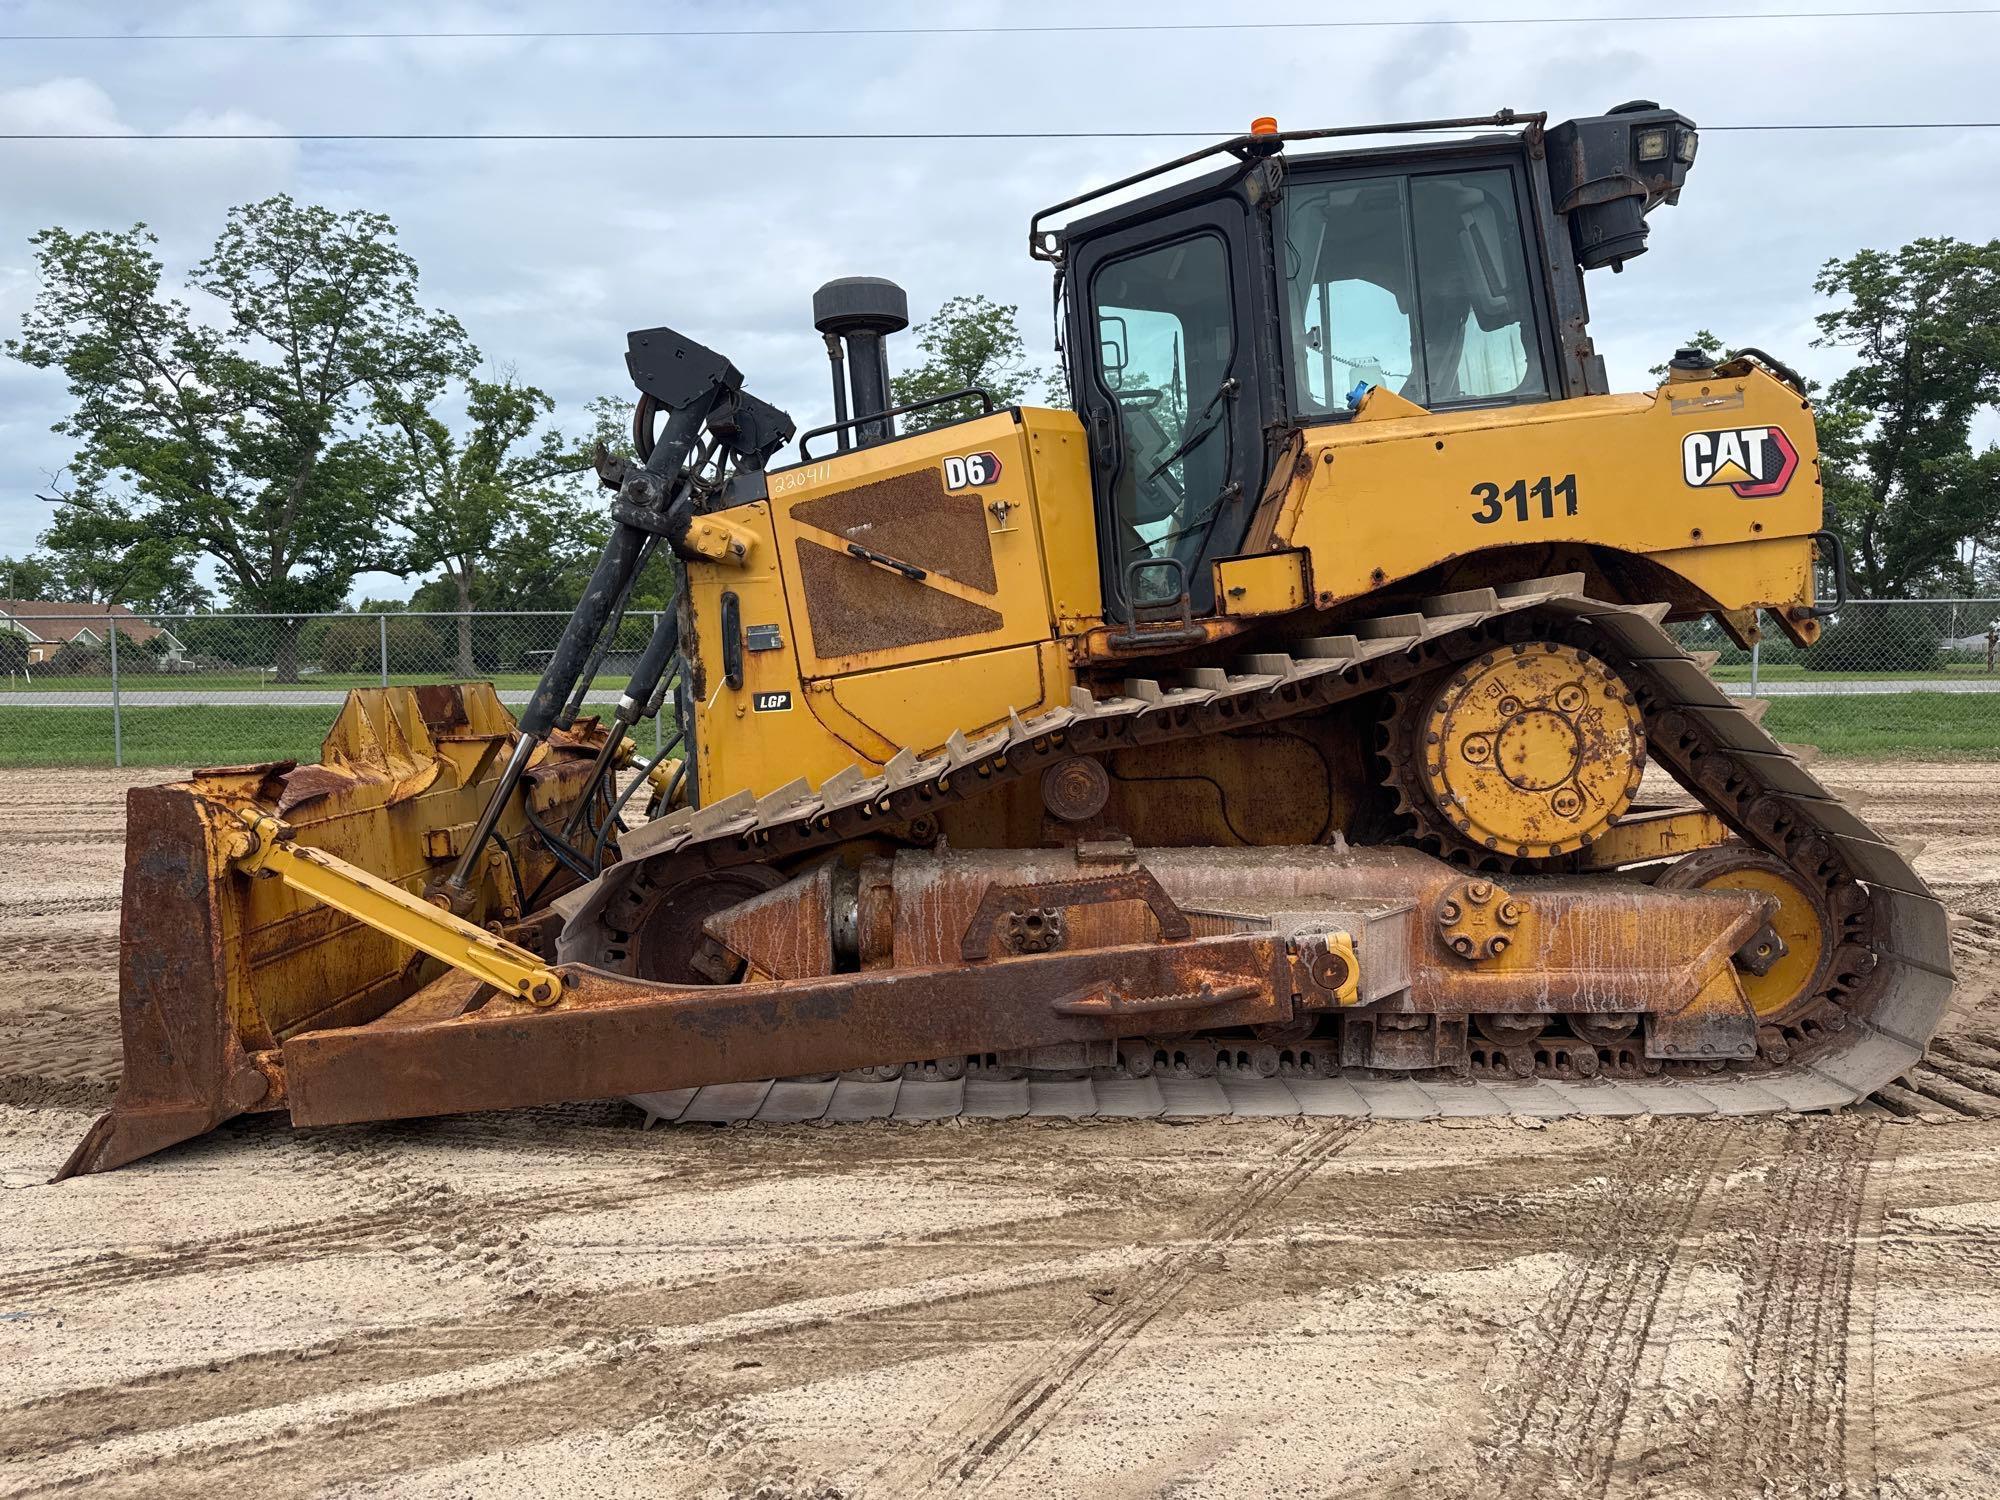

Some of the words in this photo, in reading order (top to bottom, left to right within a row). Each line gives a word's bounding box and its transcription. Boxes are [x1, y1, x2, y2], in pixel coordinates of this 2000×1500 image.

[944, 455, 986, 489] D6
[1683, 428, 1769, 486] CAT
[775, 463, 830, 493] 220411
[1470, 474, 1578, 525] 3111
[760, 695, 787, 709] LGP
